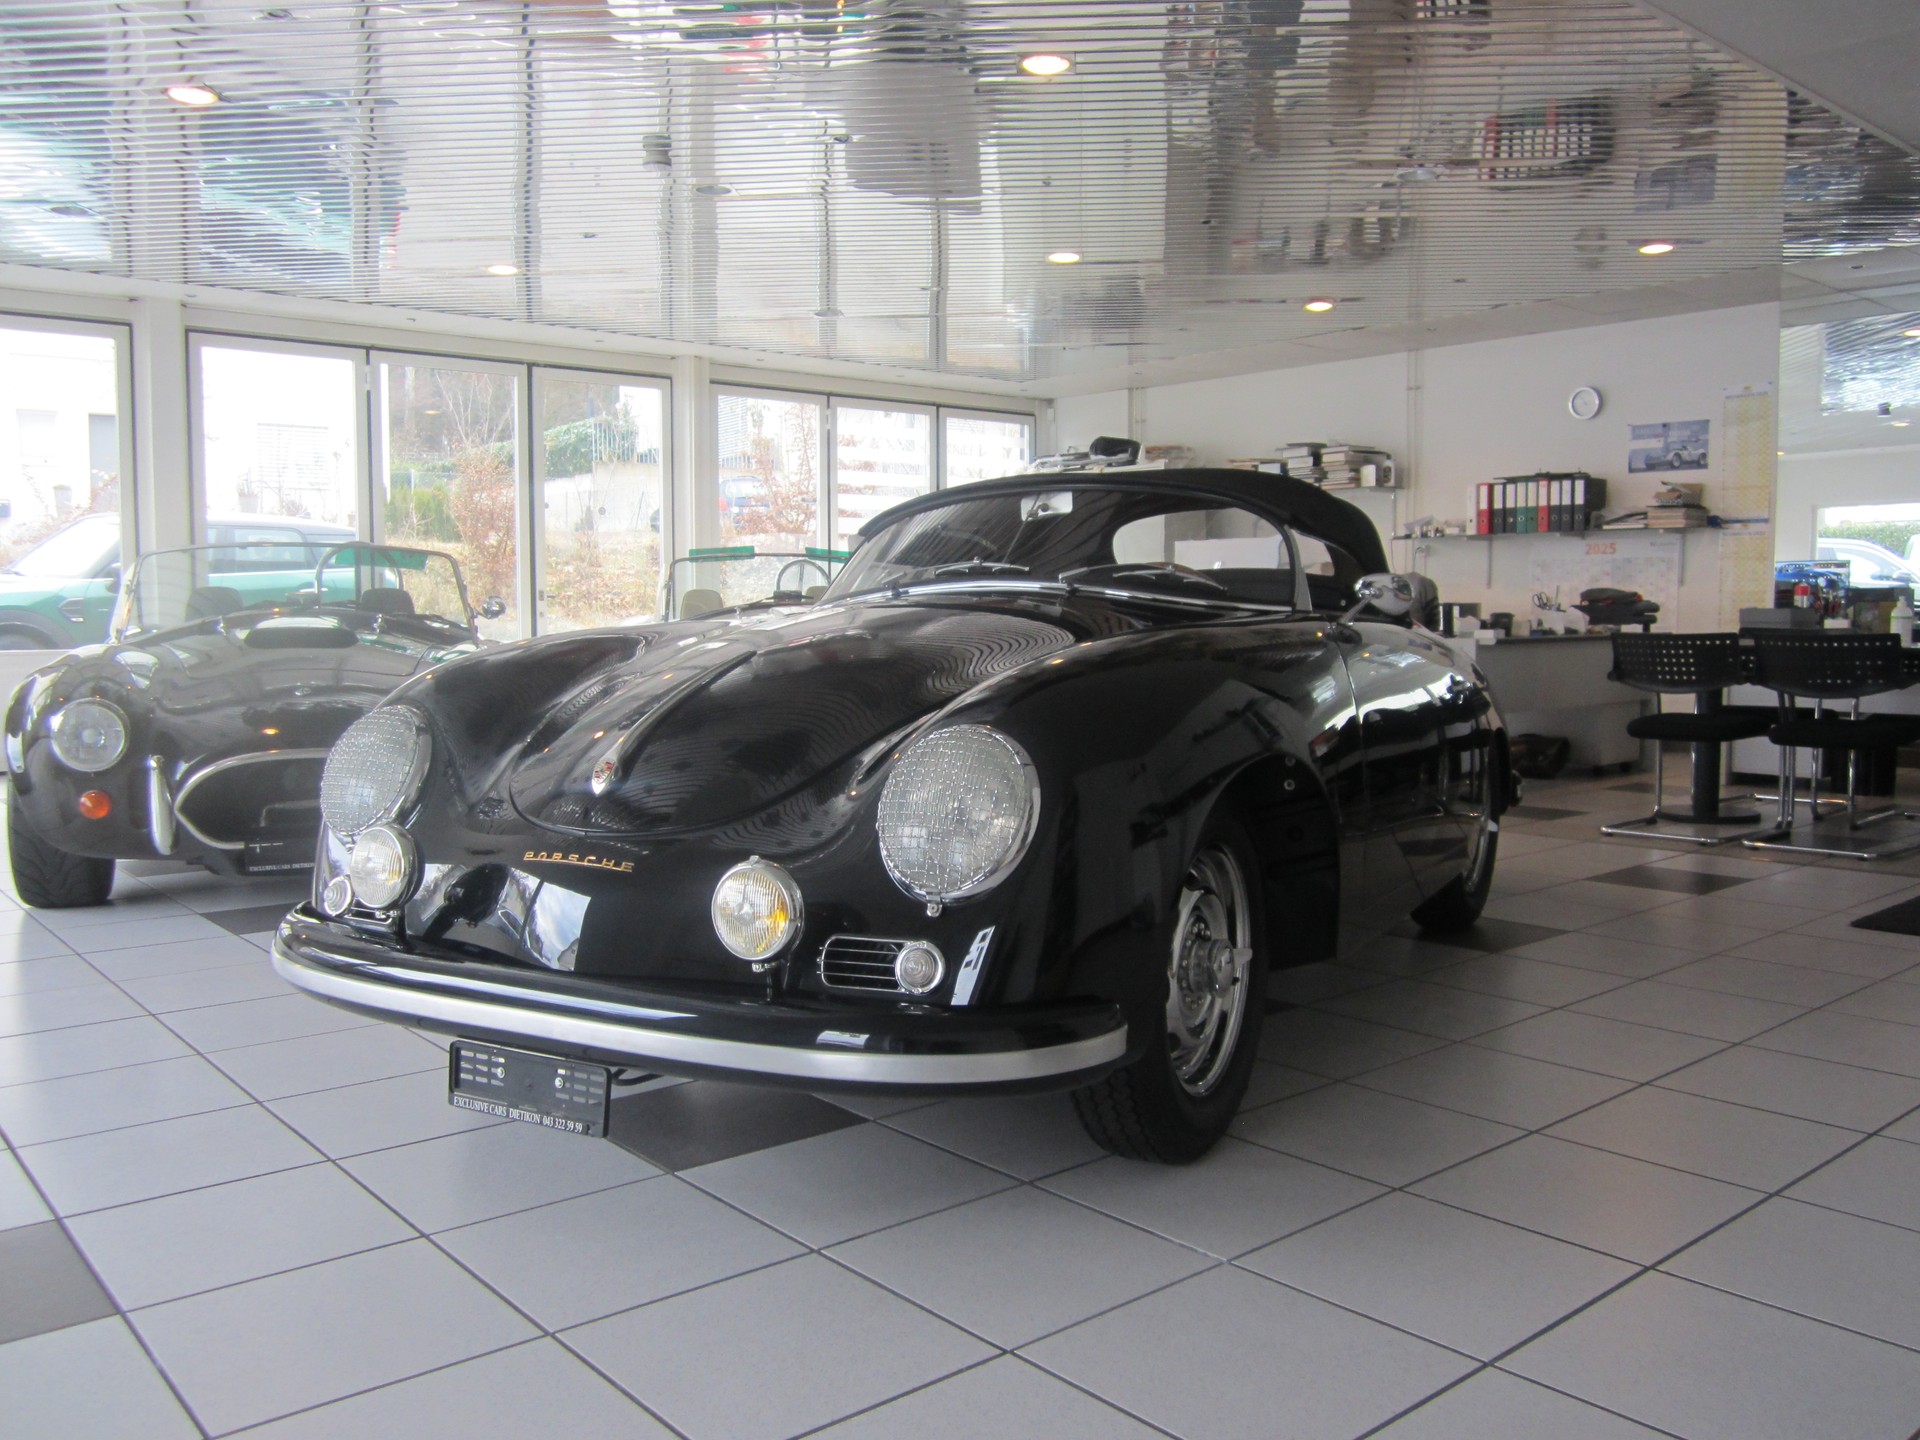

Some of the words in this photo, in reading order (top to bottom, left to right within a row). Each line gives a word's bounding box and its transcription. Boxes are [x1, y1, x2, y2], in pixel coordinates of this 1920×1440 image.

[1585, 543, 1616, 555] 2025
[523, 851, 635, 872] PORSCHE
[454, 1096, 489, 1112] EXCLUSIVE
[489, 1103, 507, 1117] CARS
[509, 1108, 541, 1123] DIETIKON
[542, 1115, 554, 1127] 043
[555, 1118, 565, 1130] 322
[566, 1120, 574, 1131] 59
[574, 1122, 583, 1133] 59
